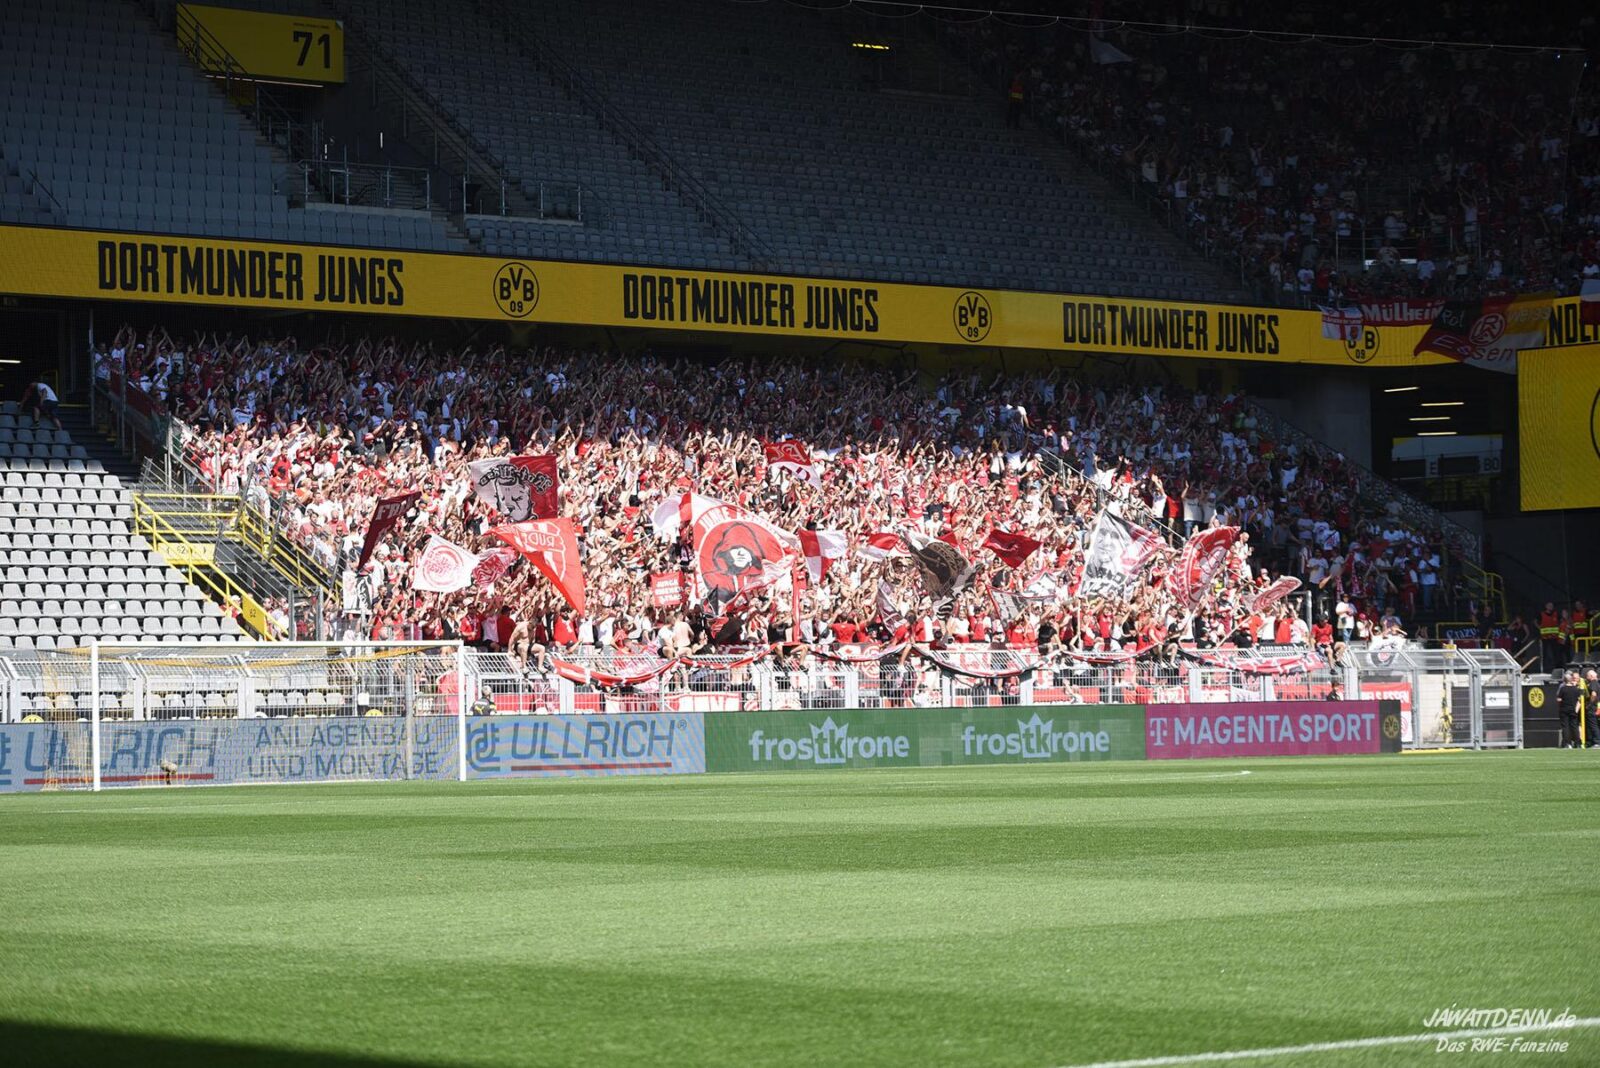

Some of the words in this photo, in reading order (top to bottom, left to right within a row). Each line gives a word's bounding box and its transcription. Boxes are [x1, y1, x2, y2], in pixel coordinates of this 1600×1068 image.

[293, 30, 331, 69] 71
[98, 240, 304, 301] DORTMUNDER
[314, 254, 404, 306] JUNGS
[499, 267, 535, 302] BVB
[510, 300, 524, 313] 09
[623, 273, 795, 328] DORTMUNDER
[803, 285, 879, 333] JUNGS
[958, 296, 989, 328] BVB
[967, 326, 979, 338] 09
[1063, 302, 1208, 351] DORTMUNDER
[1215, 312, 1280, 355] JUNGS
[256, 723, 431, 748] ANLAGENBAU
[749, 716, 910, 764] frostkrone
[961, 712, 1110, 758] frostkrone
[1174, 714, 1295, 745] MAGENTA
[1299, 713, 1375, 742] SPORT
[248, 755, 305, 777] UND
[316, 751, 438, 776] MONTAGE
